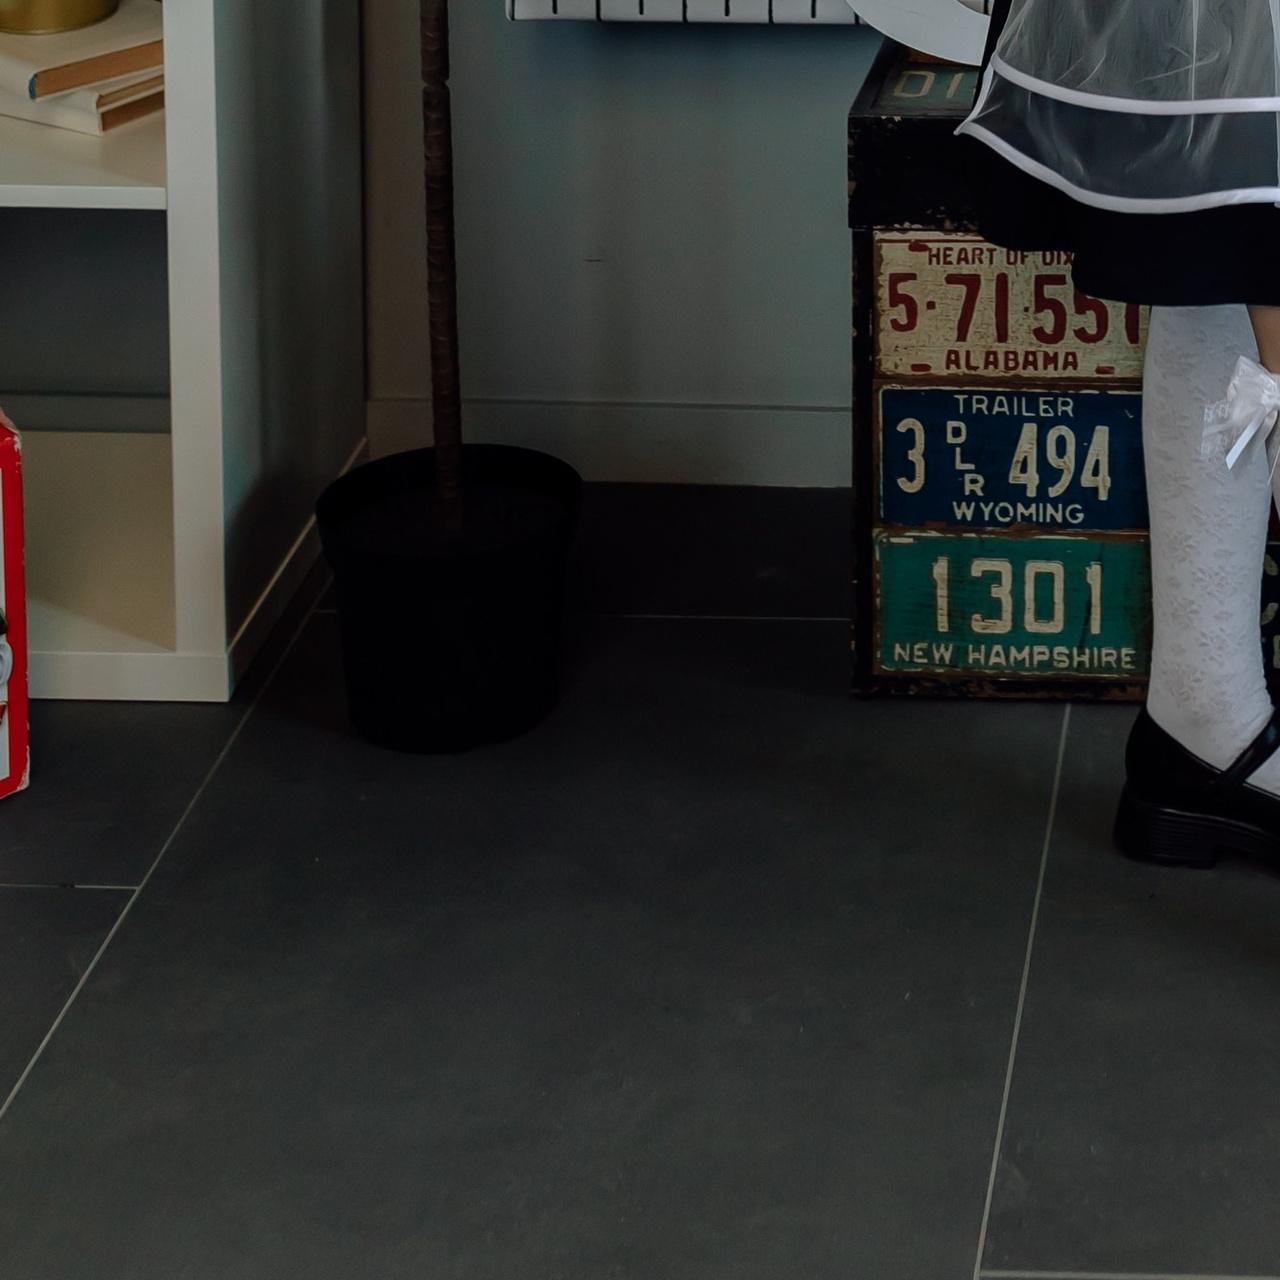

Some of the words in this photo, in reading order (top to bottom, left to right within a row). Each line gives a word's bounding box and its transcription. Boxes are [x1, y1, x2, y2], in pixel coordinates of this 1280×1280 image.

[927, 247, 997, 266] HEART
[1006, 250, 1029, 266] OF
[945, 349, 1079, 371] ALABAMA
[953, 394, 1074, 418] TRAILER
[896, 418, 925, 493] 3
[1008, 423, 1111, 500] 494
[952, 501, 1085, 524] WYOMING
[931, 555, 1102, 635] 1301
[894, 642, 954, 665] NEW
[968, 644, 1136, 670] HAMPSHIRE
